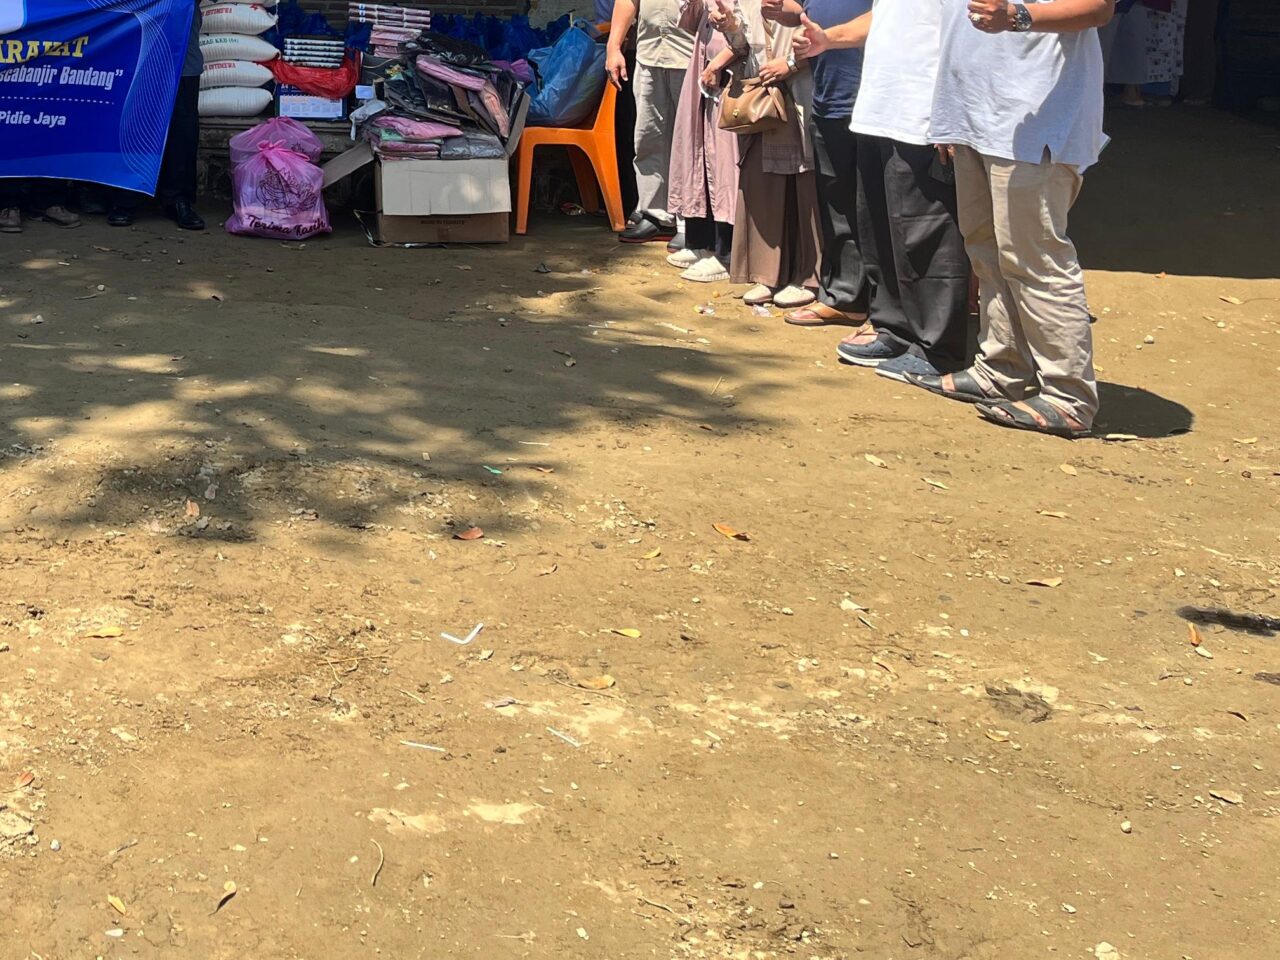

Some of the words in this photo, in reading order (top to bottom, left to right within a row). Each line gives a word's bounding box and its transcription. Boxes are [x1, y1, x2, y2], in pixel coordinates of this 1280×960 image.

[59, 66, 124, 90] Bandang”
[33, 112, 66, 128] Jaya
[247, 214, 292, 234] Terima
[292, 218, 325, 236] Kasih
